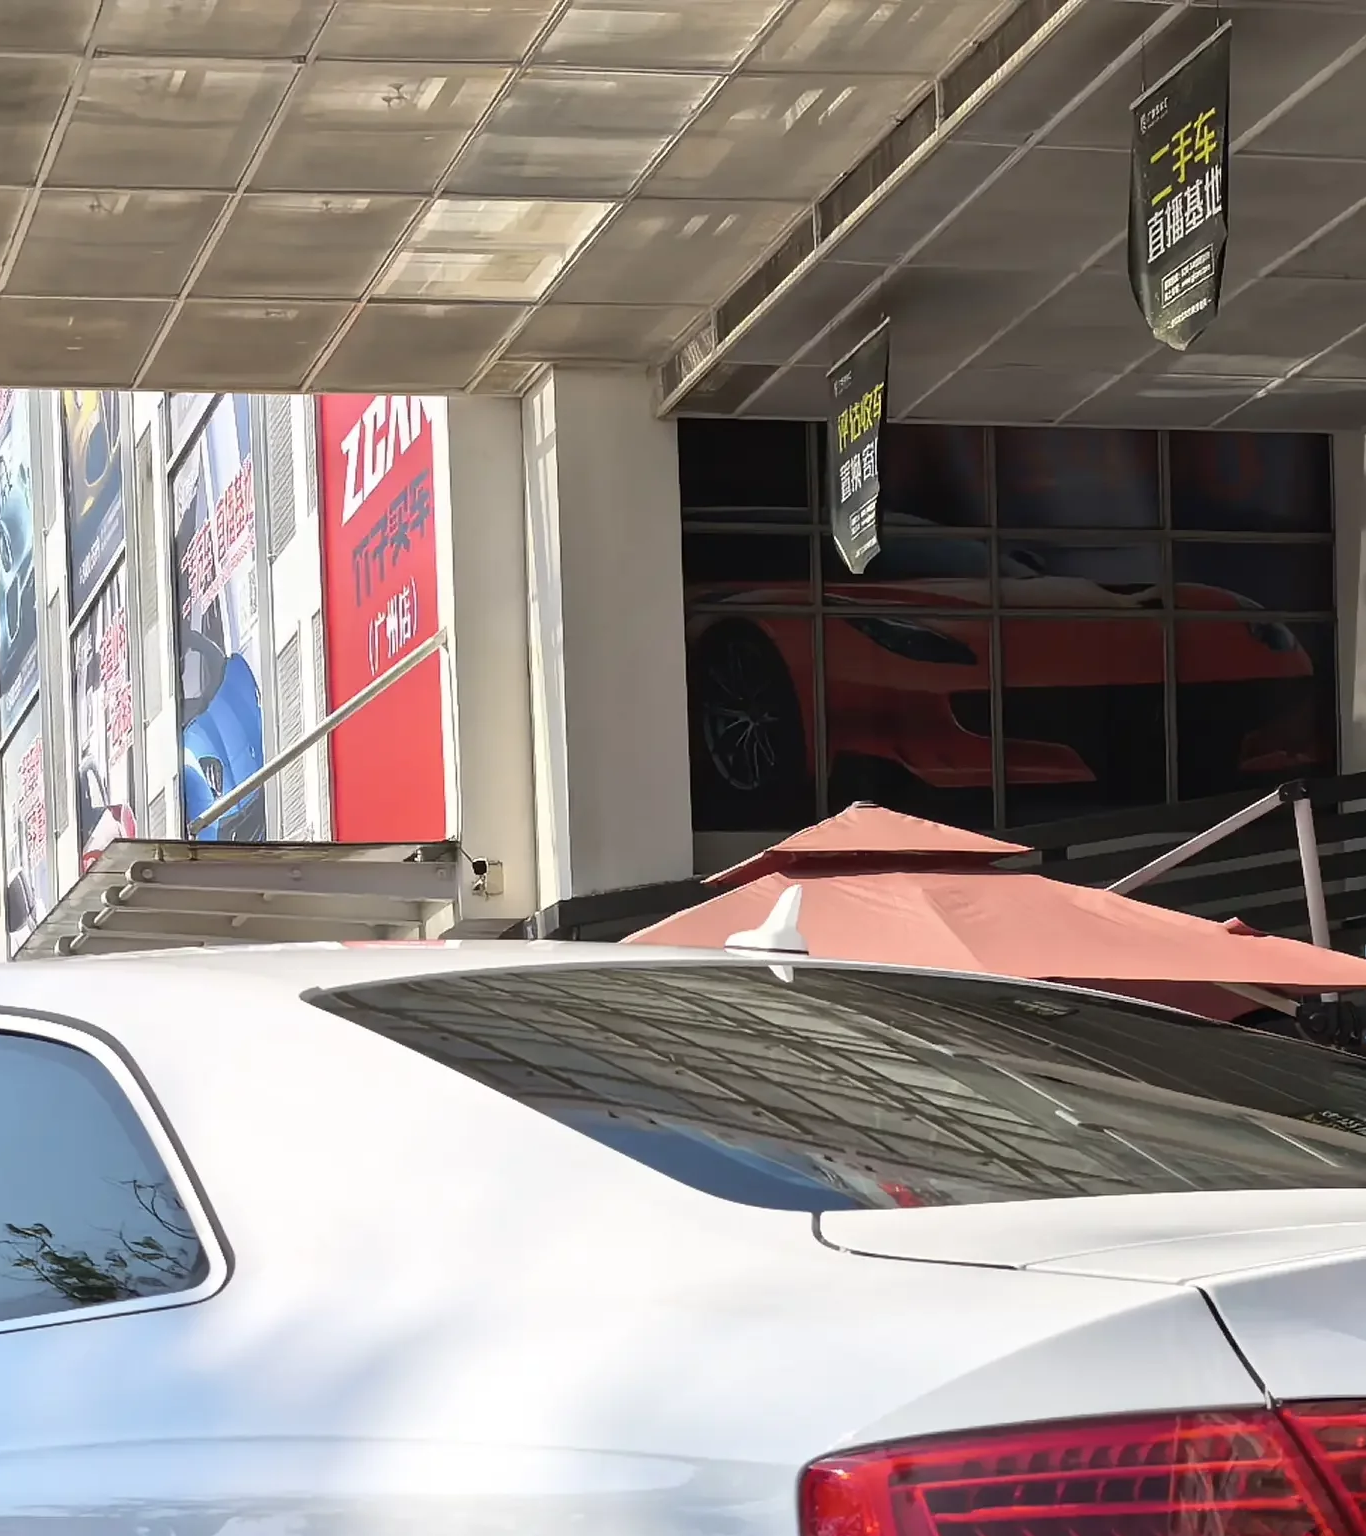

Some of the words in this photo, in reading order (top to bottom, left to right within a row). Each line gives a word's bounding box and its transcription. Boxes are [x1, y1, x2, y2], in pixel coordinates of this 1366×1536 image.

[1149, 107, 1218, 206] 二手车
[1146, 163, 1223, 264] 直播基地
[839, 437, 878, 504] 置换寄
